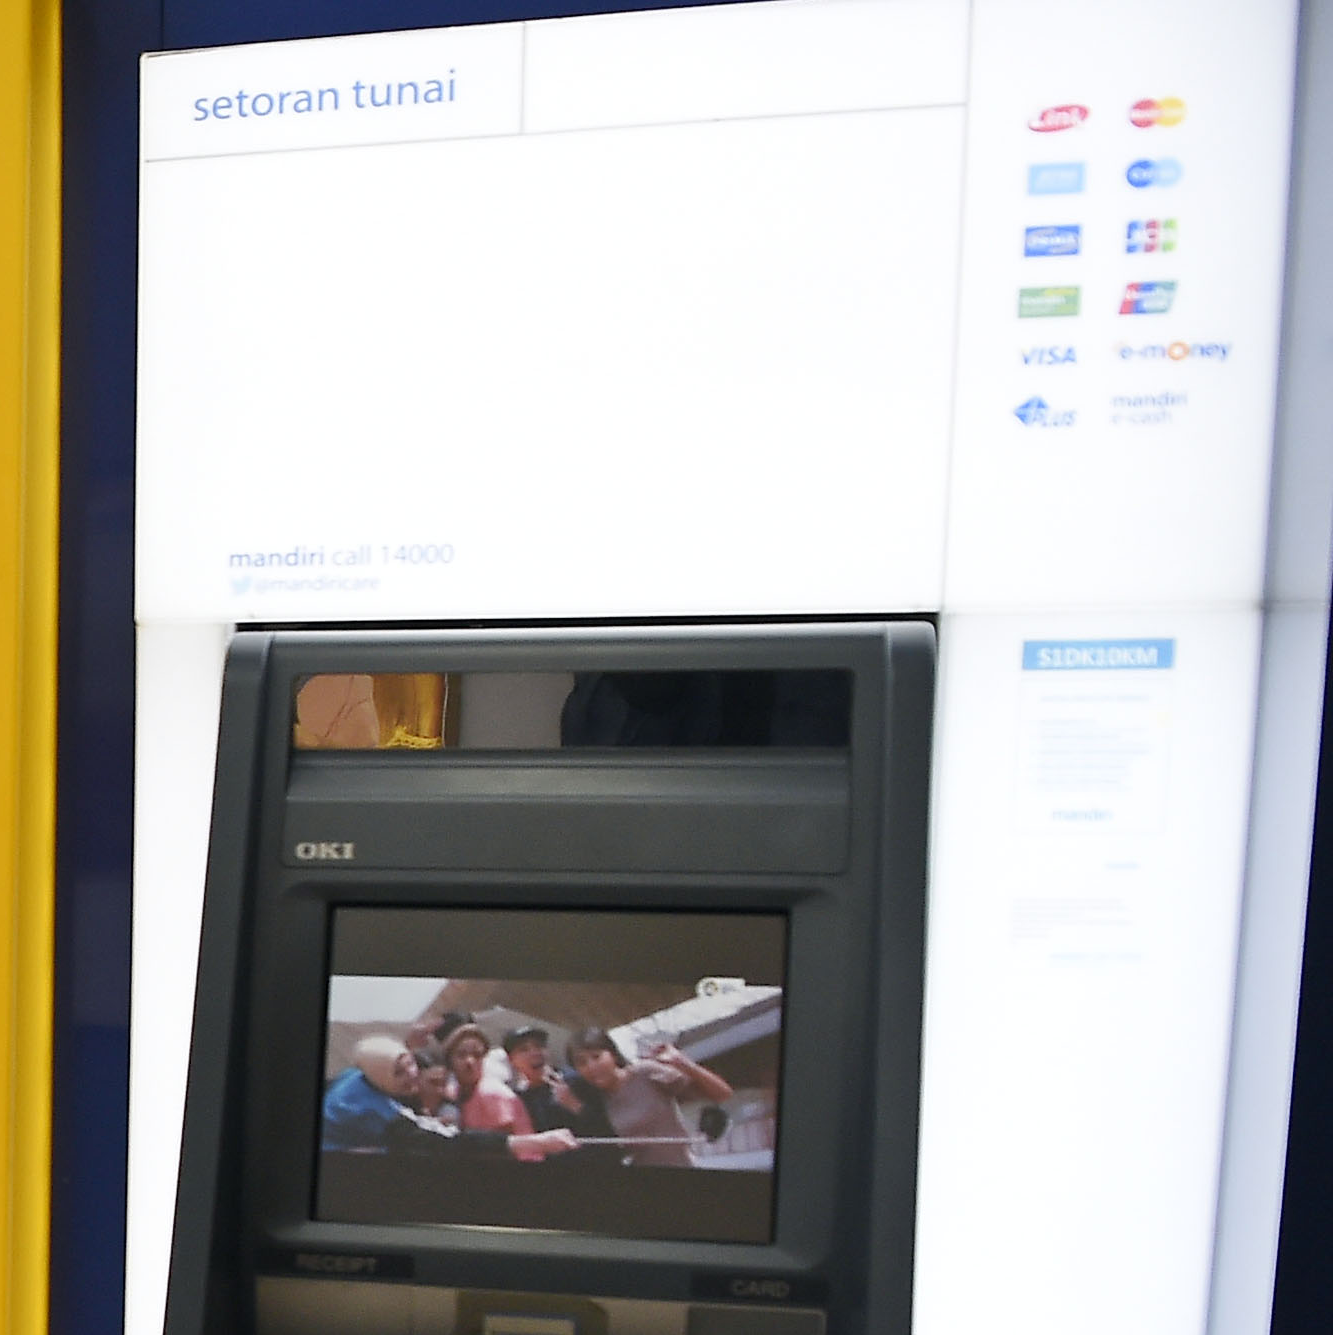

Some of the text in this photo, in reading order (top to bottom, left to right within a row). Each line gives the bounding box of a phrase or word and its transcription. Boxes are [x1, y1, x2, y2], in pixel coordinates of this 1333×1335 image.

[193, 68, 458, 123] setoran tunai
[1021, 345, 1077, 366] VISA
[229, 543, 454, 568] mandiri call 14000
[295, 842, 356, 860] OKI
[730, 1278, 790, 1298] CARD
